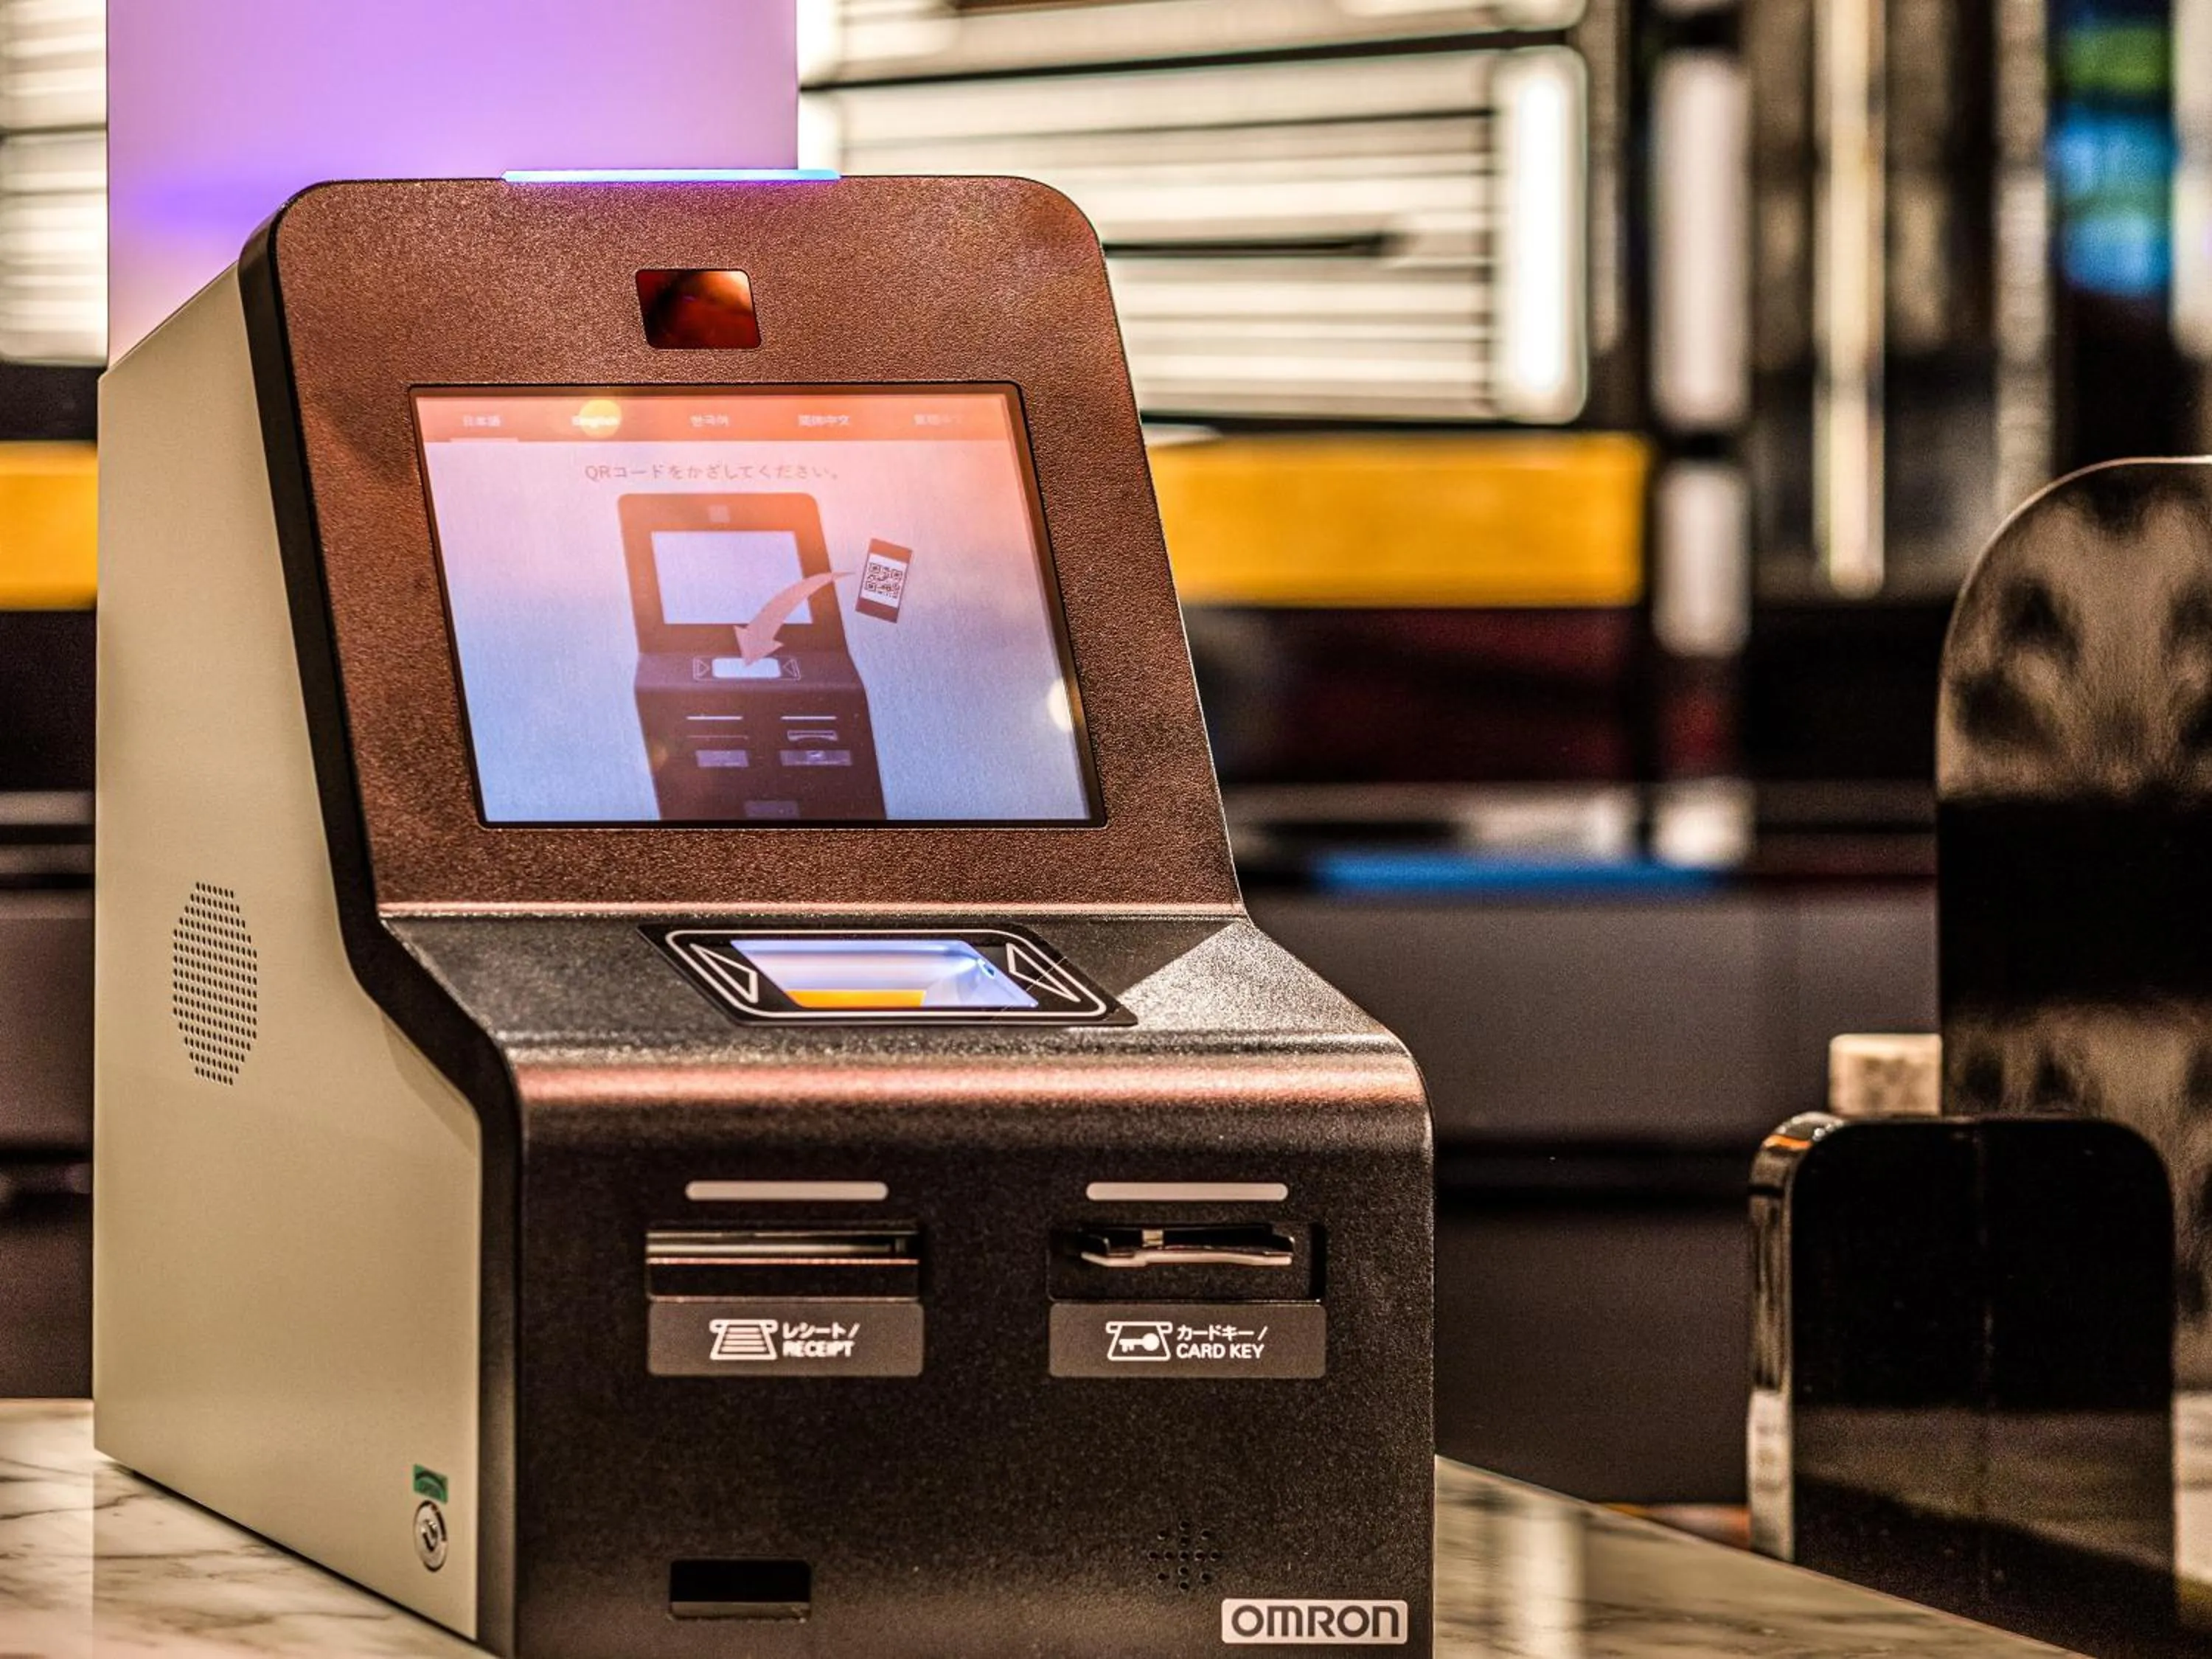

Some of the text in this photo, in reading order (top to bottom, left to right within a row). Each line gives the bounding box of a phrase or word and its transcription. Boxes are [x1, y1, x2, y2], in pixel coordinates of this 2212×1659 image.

[585, 464, 838, 481] QRコードをかざしてください。
[782, 1340, 855, 1357] RECEIPT
[1175, 1343, 1265, 1359] CARD KEY
[1231, 1604, 1399, 1638] OMRON
